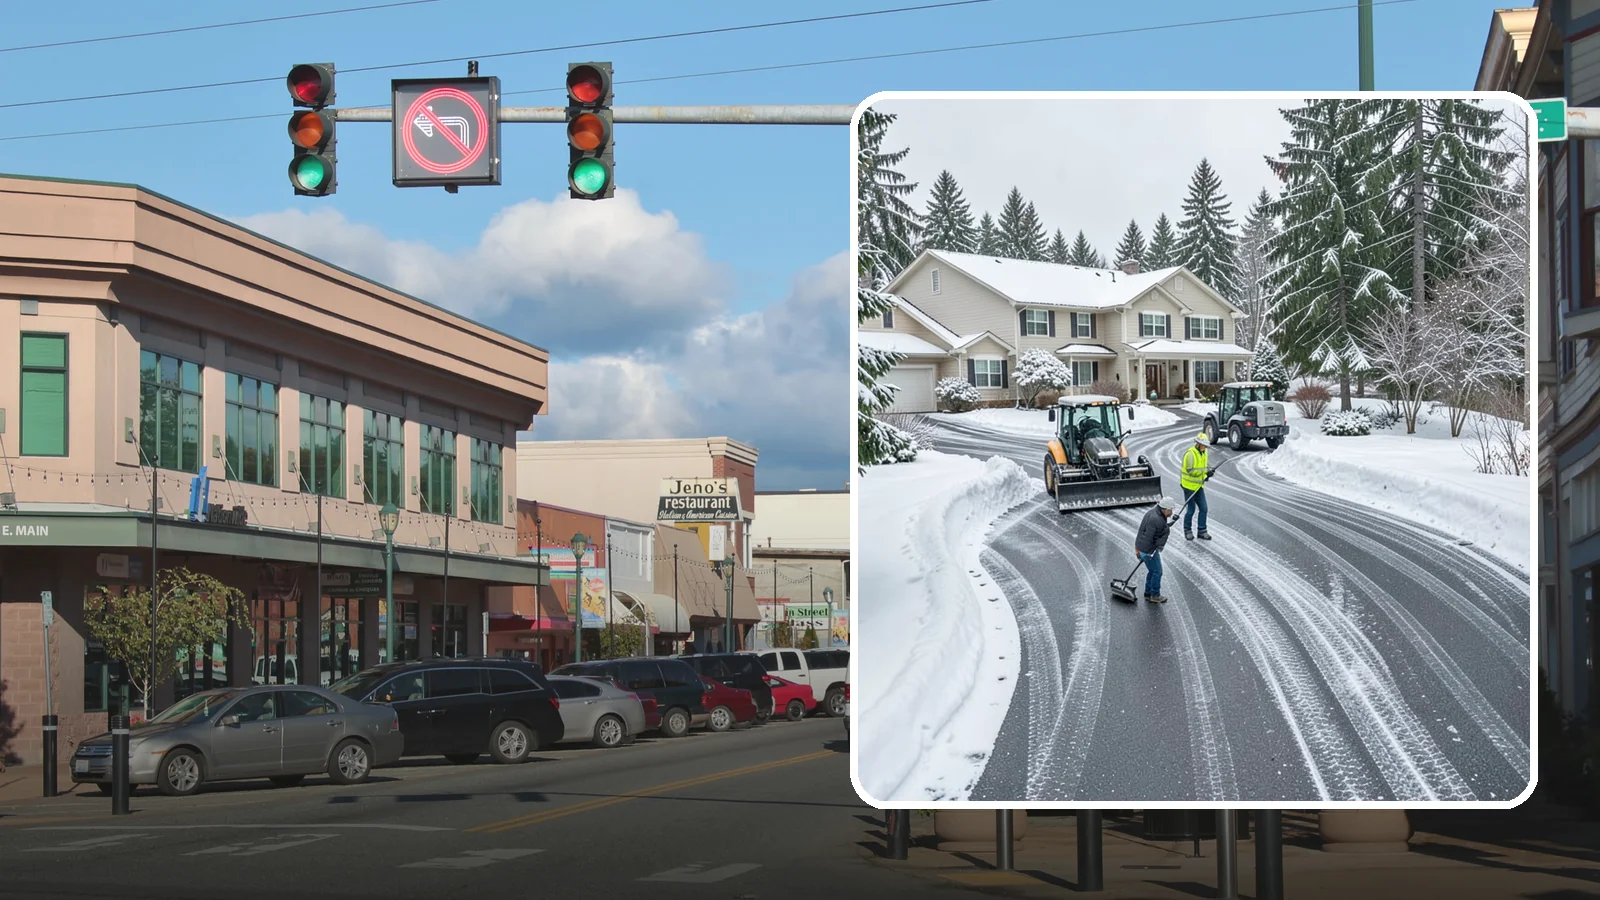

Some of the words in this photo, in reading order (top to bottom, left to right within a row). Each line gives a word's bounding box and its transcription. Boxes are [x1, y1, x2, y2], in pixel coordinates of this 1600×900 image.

[670, 480, 727, 494] Jeno's
[665, 496, 730, 509] restaurant
[659, 510, 682, 519] Italian
[686, 510, 714, 519] American
[715, 509, 737, 519] Cuisine
[2, 525, 13, 536] E.
[15, 525, 49, 536] MAIN
[797, 607, 828, 616] Street
